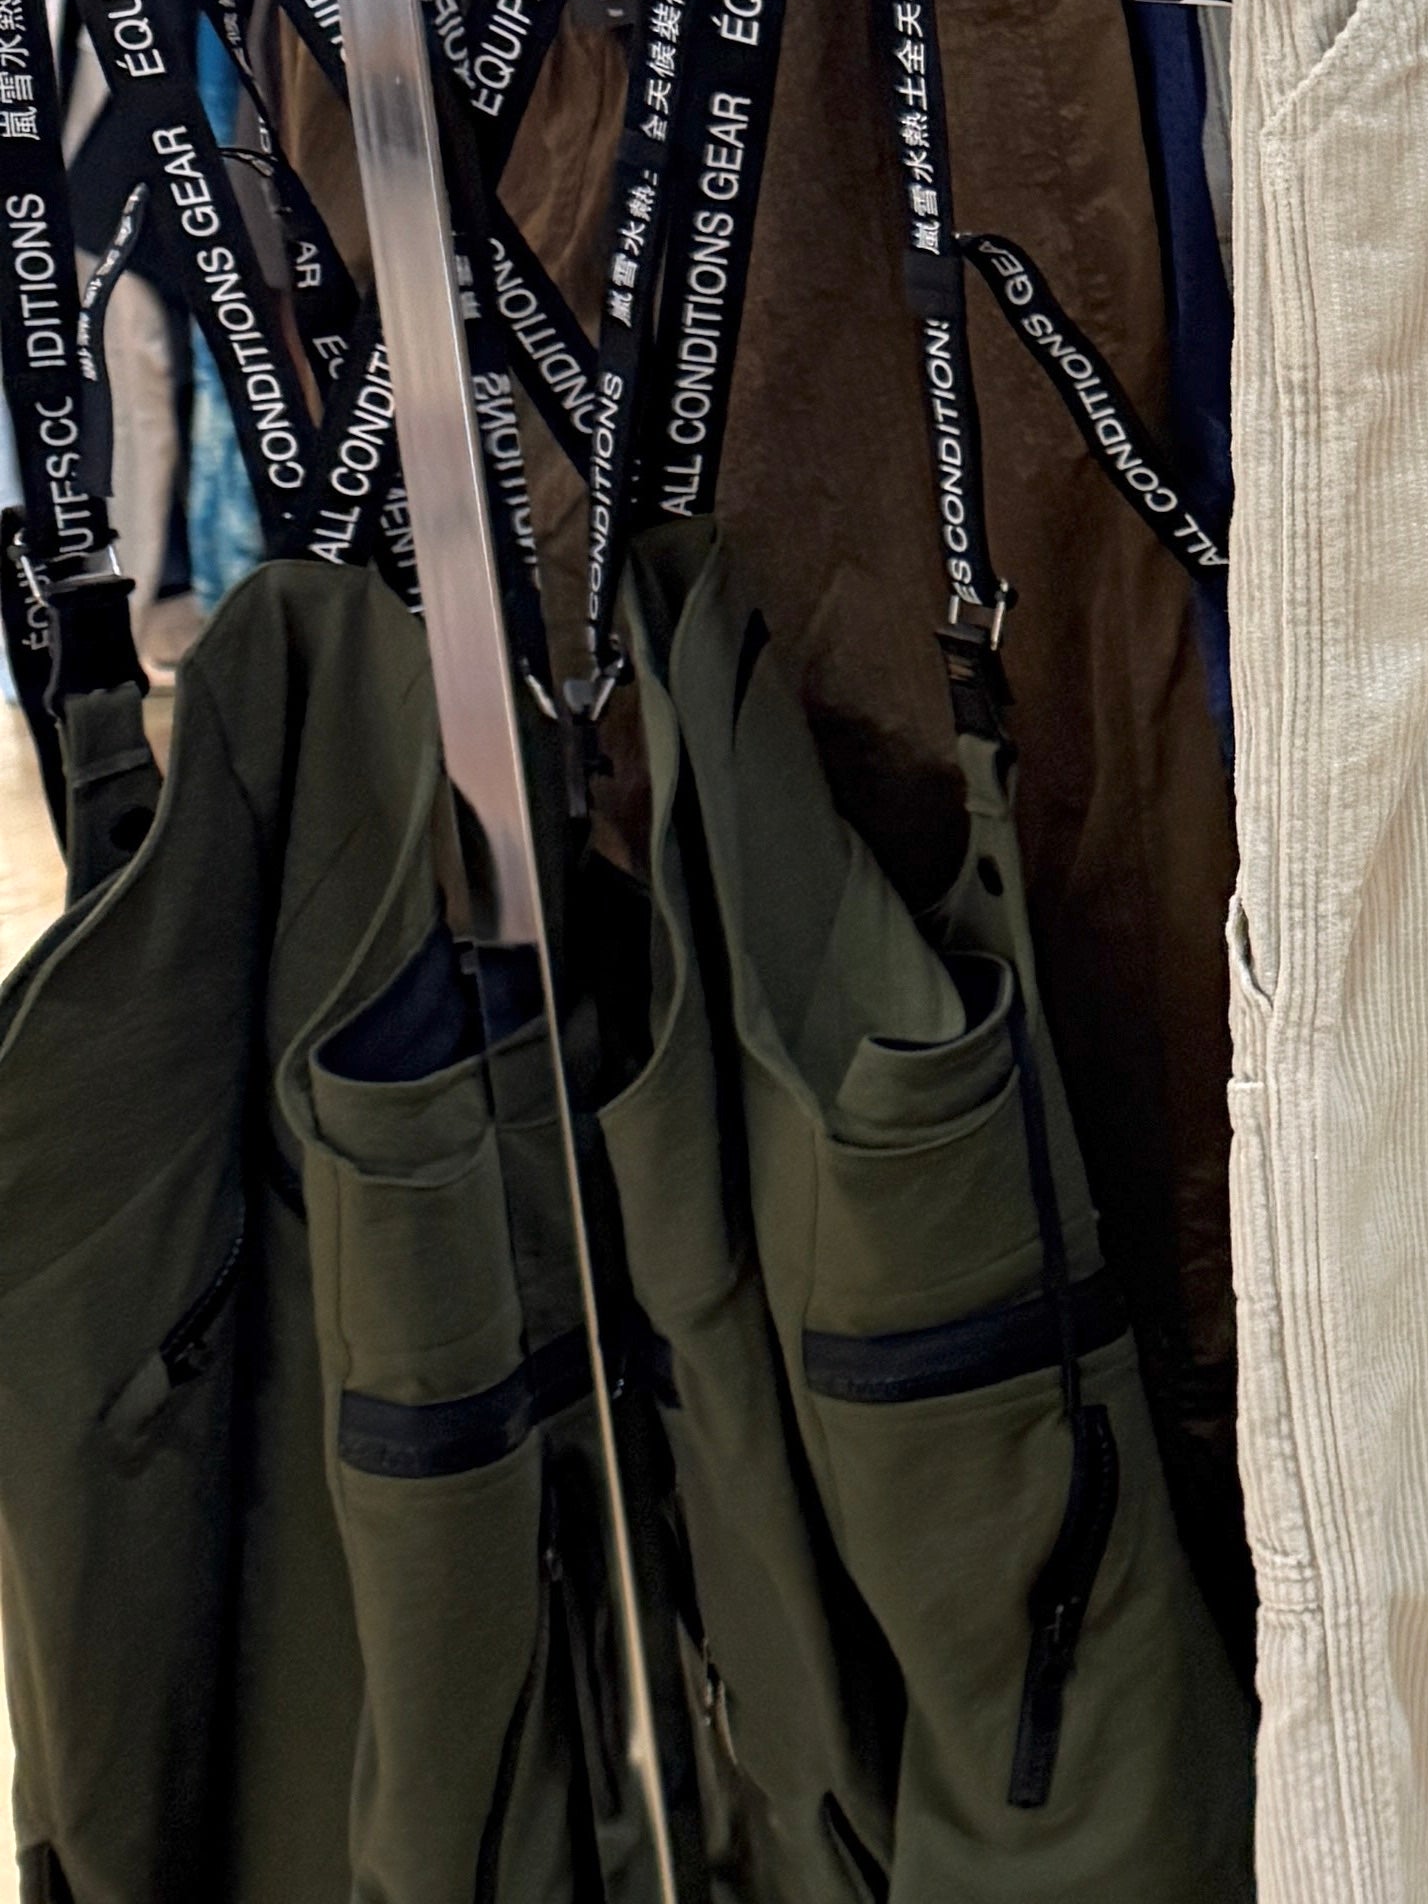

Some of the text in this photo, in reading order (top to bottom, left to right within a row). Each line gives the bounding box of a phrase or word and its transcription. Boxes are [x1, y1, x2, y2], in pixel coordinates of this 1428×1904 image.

[151, 124, 221, 238] GEAR
[702, 92, 752, 201] GEAR
[195, 245, 307, 490] CONDITIONS
[667, 210, 735, 444] CONDITIONS
[1020, 312, 1179, 514] CONDITIONS
[307, 504, 362, 566] ALL
[660, 453, 704, 517] ALL
[1172, 512, 1232, 567] ALL
